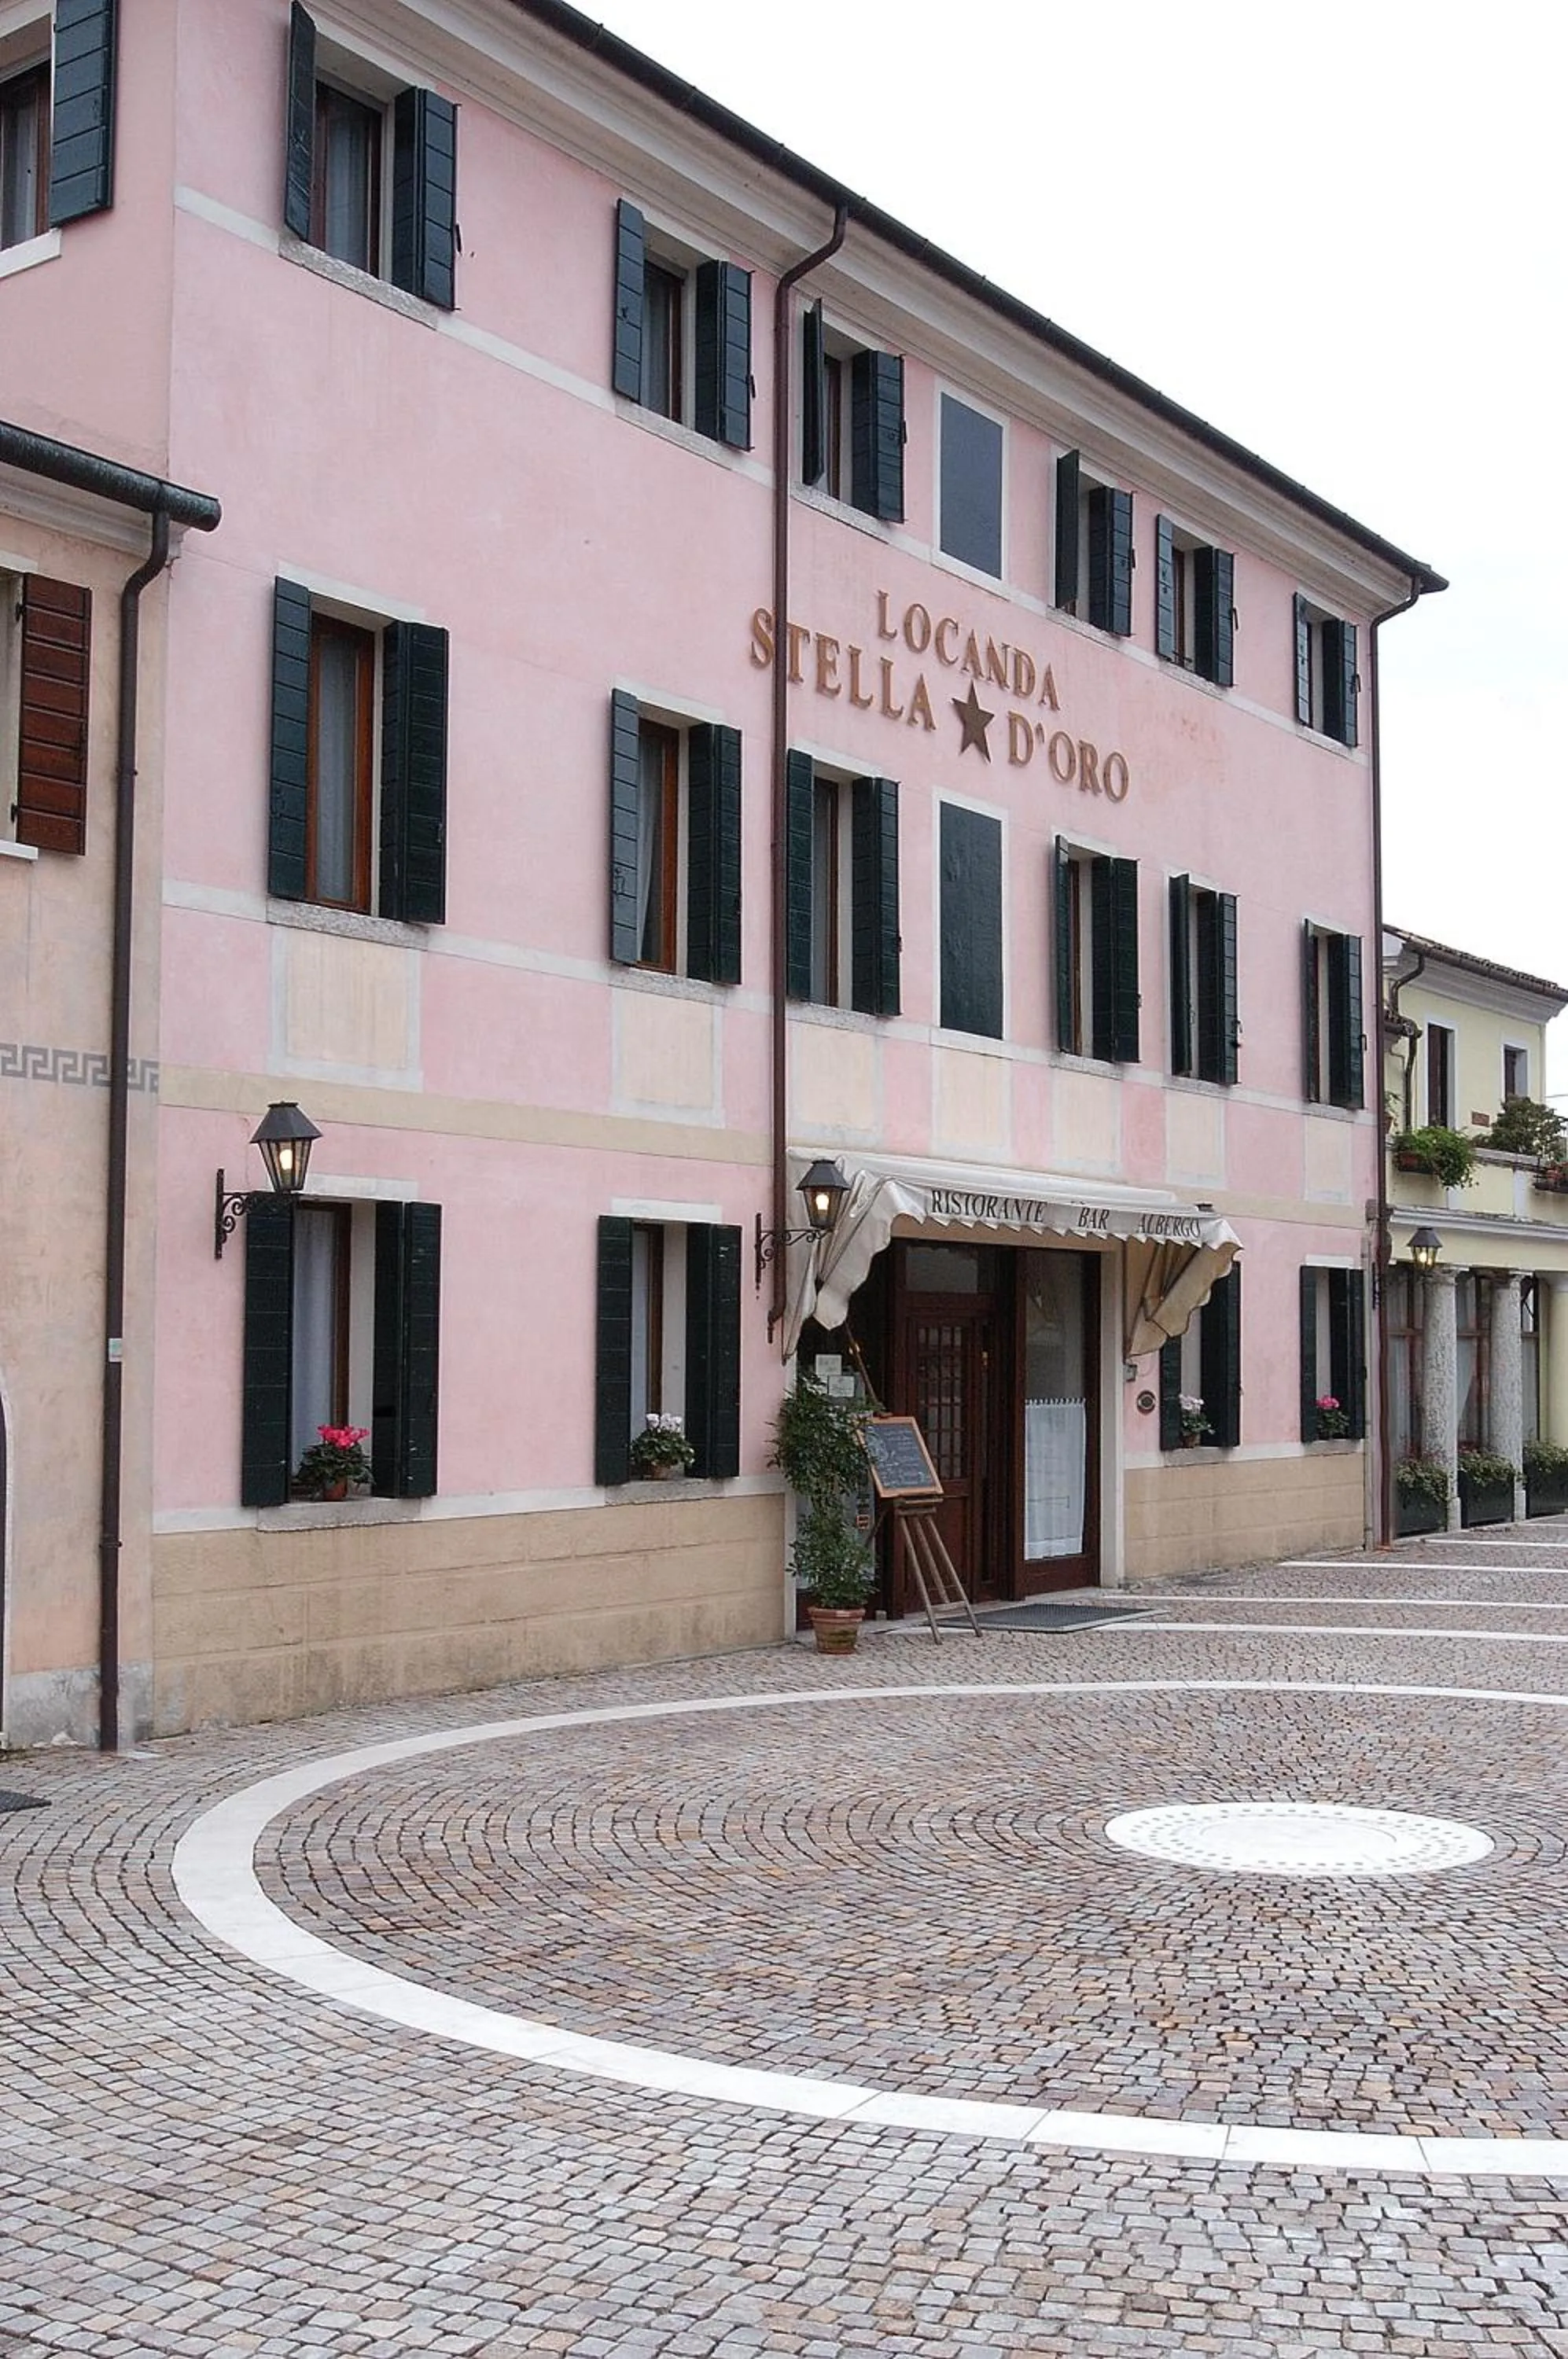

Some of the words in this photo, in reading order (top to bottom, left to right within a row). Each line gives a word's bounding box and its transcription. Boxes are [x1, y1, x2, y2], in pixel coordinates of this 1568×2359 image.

[750, 608, 937, 731] STELLA
[1007, 711, 1130, 803] D'ORO
[877, 591, 1061, 711] LOCANDA
[931, 1190, 1047, 1223] RISTORANTE
[1078, 1207, 1110, 1230] BAR
[1137, 1213, 1201, 1238] ALBERGO
